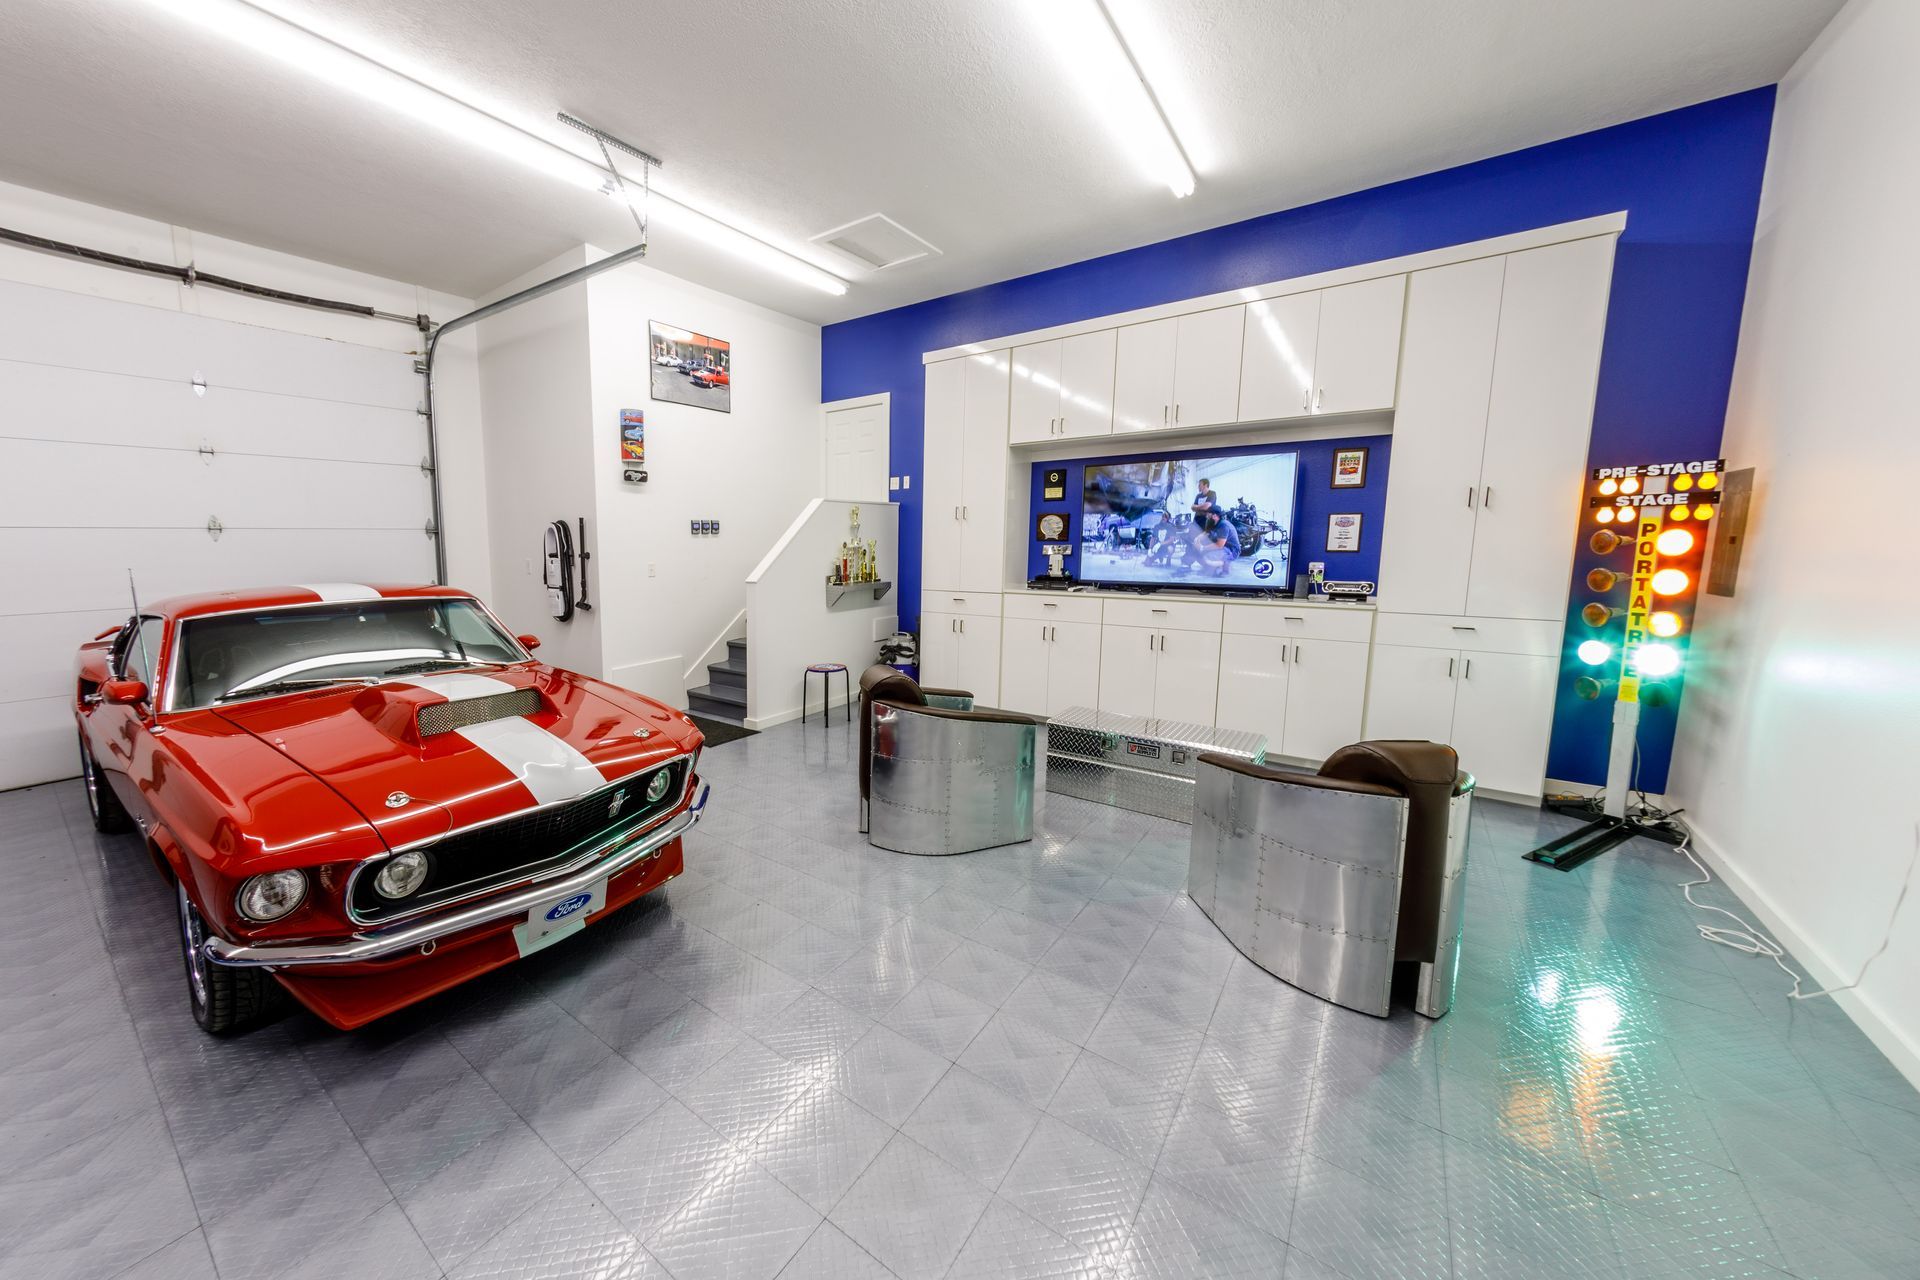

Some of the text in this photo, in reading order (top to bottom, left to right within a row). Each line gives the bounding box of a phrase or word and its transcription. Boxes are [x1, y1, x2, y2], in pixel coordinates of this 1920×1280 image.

[1599, 460, 1717, 480] PRE-STAGE
[1615, 493, 1689, 507] STAGE
[554, 897, 585, 918] Ford
